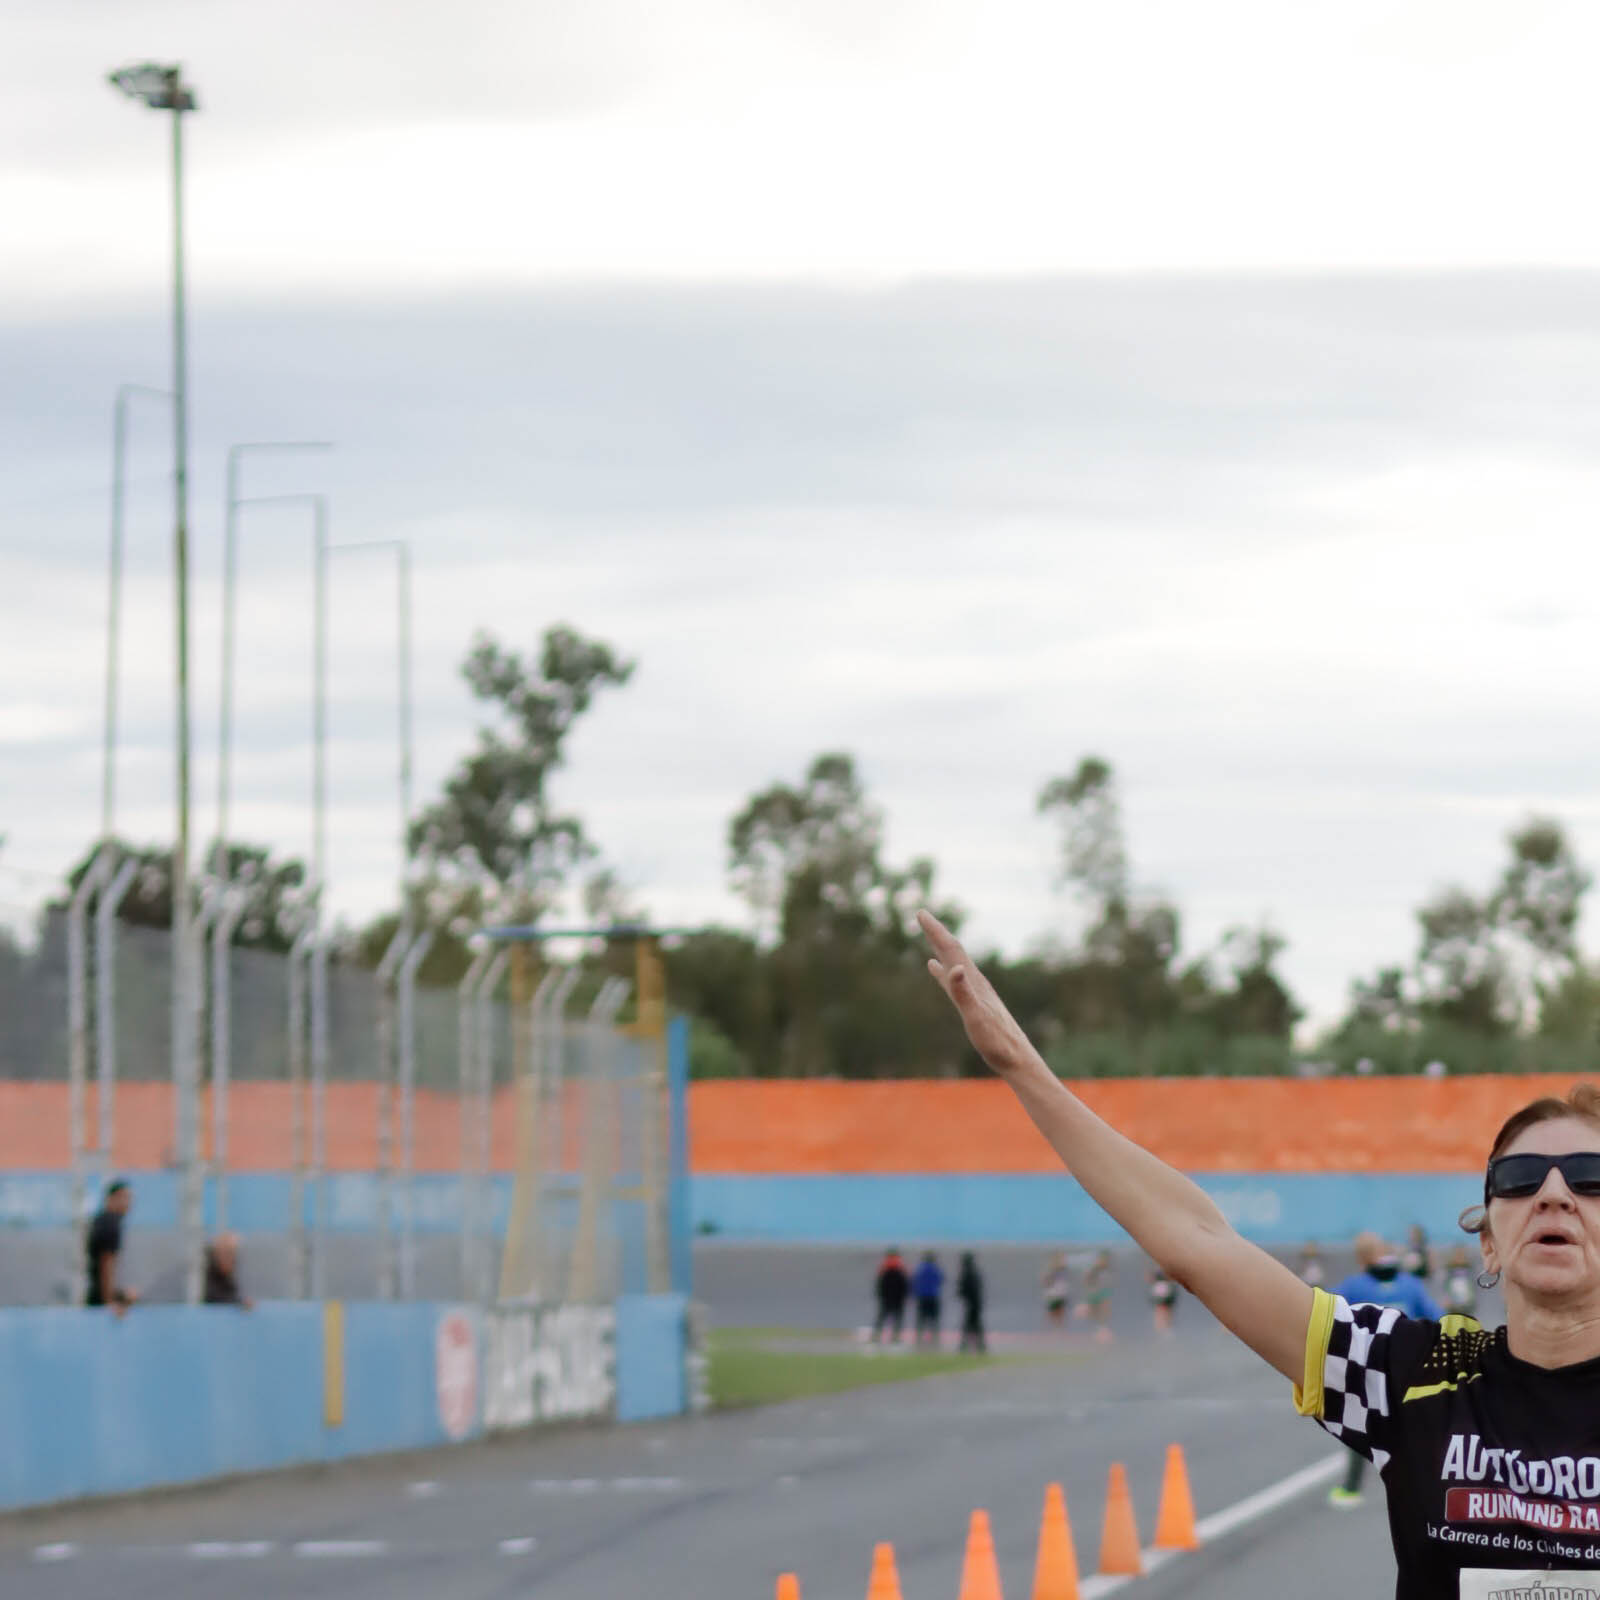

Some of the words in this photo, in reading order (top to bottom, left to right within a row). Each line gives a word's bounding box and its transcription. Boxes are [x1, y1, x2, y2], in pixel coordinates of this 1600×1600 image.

[1468, 1493, 1563, 1529] RUNNING
[1440, 1526, 1489, 1546] Carrera
[1492, 1532, 1510, 1548] de
[1513, 1533, 1533, 1551] los
[1536, 1539, 1581, 1559] Clubes
